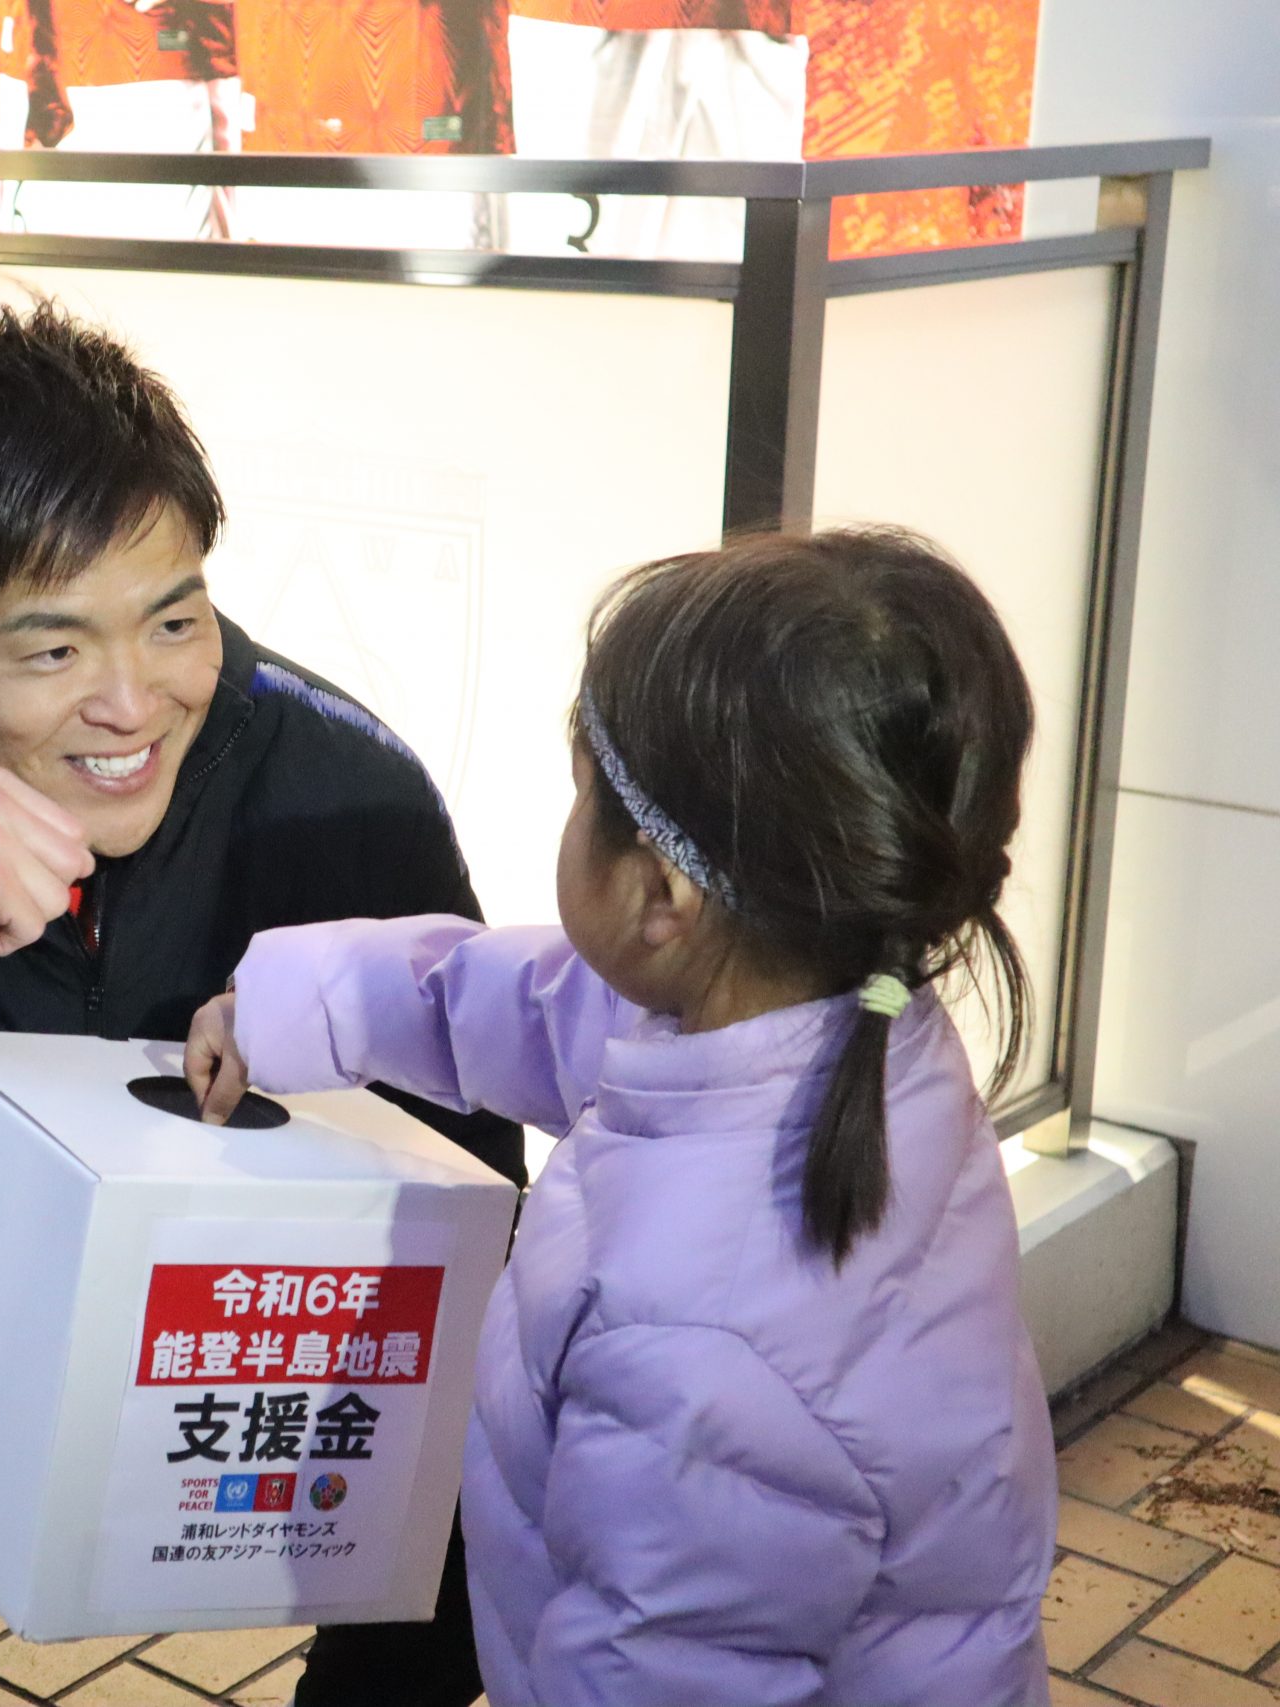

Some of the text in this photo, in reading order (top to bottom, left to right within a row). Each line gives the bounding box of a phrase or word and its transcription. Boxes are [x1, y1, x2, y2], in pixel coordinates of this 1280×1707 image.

[213, 1268, 382, 1320] 令和6年
[150, 1329, 422, 1380] 能登半島地震
[166, 1391, 381, 1463] 支援金
[181, 1478, 219, 1487] SPORTS
[189, 1490, 209, 1499] FOR
[178, 1501, 213, 1511] PEACE!
[181, 1521, 338, 1540] 浦和レッドダイヤモンズ
